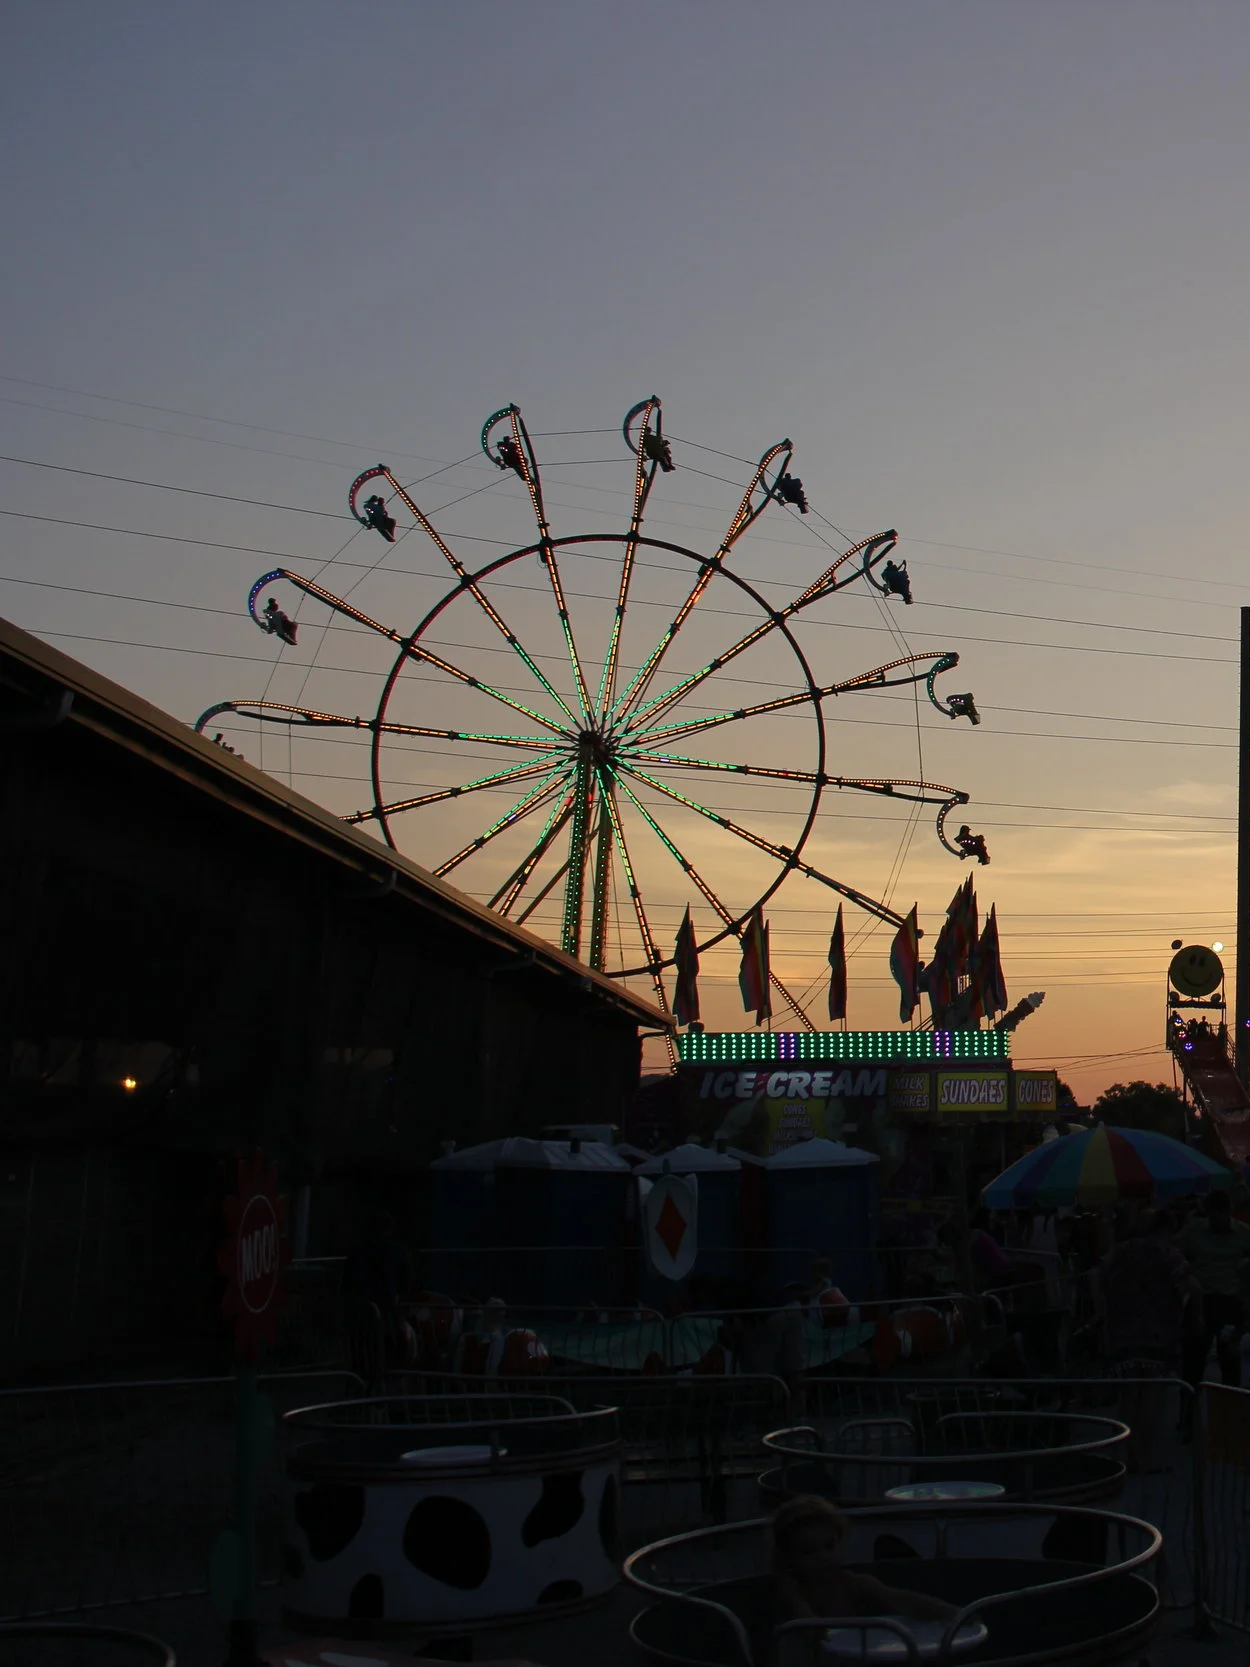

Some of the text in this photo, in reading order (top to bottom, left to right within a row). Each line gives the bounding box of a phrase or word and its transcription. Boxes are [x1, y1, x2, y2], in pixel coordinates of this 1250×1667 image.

[700, 1069, 887, 1099] ICE CREAM
[892, 1075, 925, 1091] MILK
[941, 1079, 1006, 1105] SUNDAES
[1018, 1079, 1054, 1104] CONES
[889, 1093, 929, 1109] SHAKES
[241, 1223, 276, 1289] MOO!
